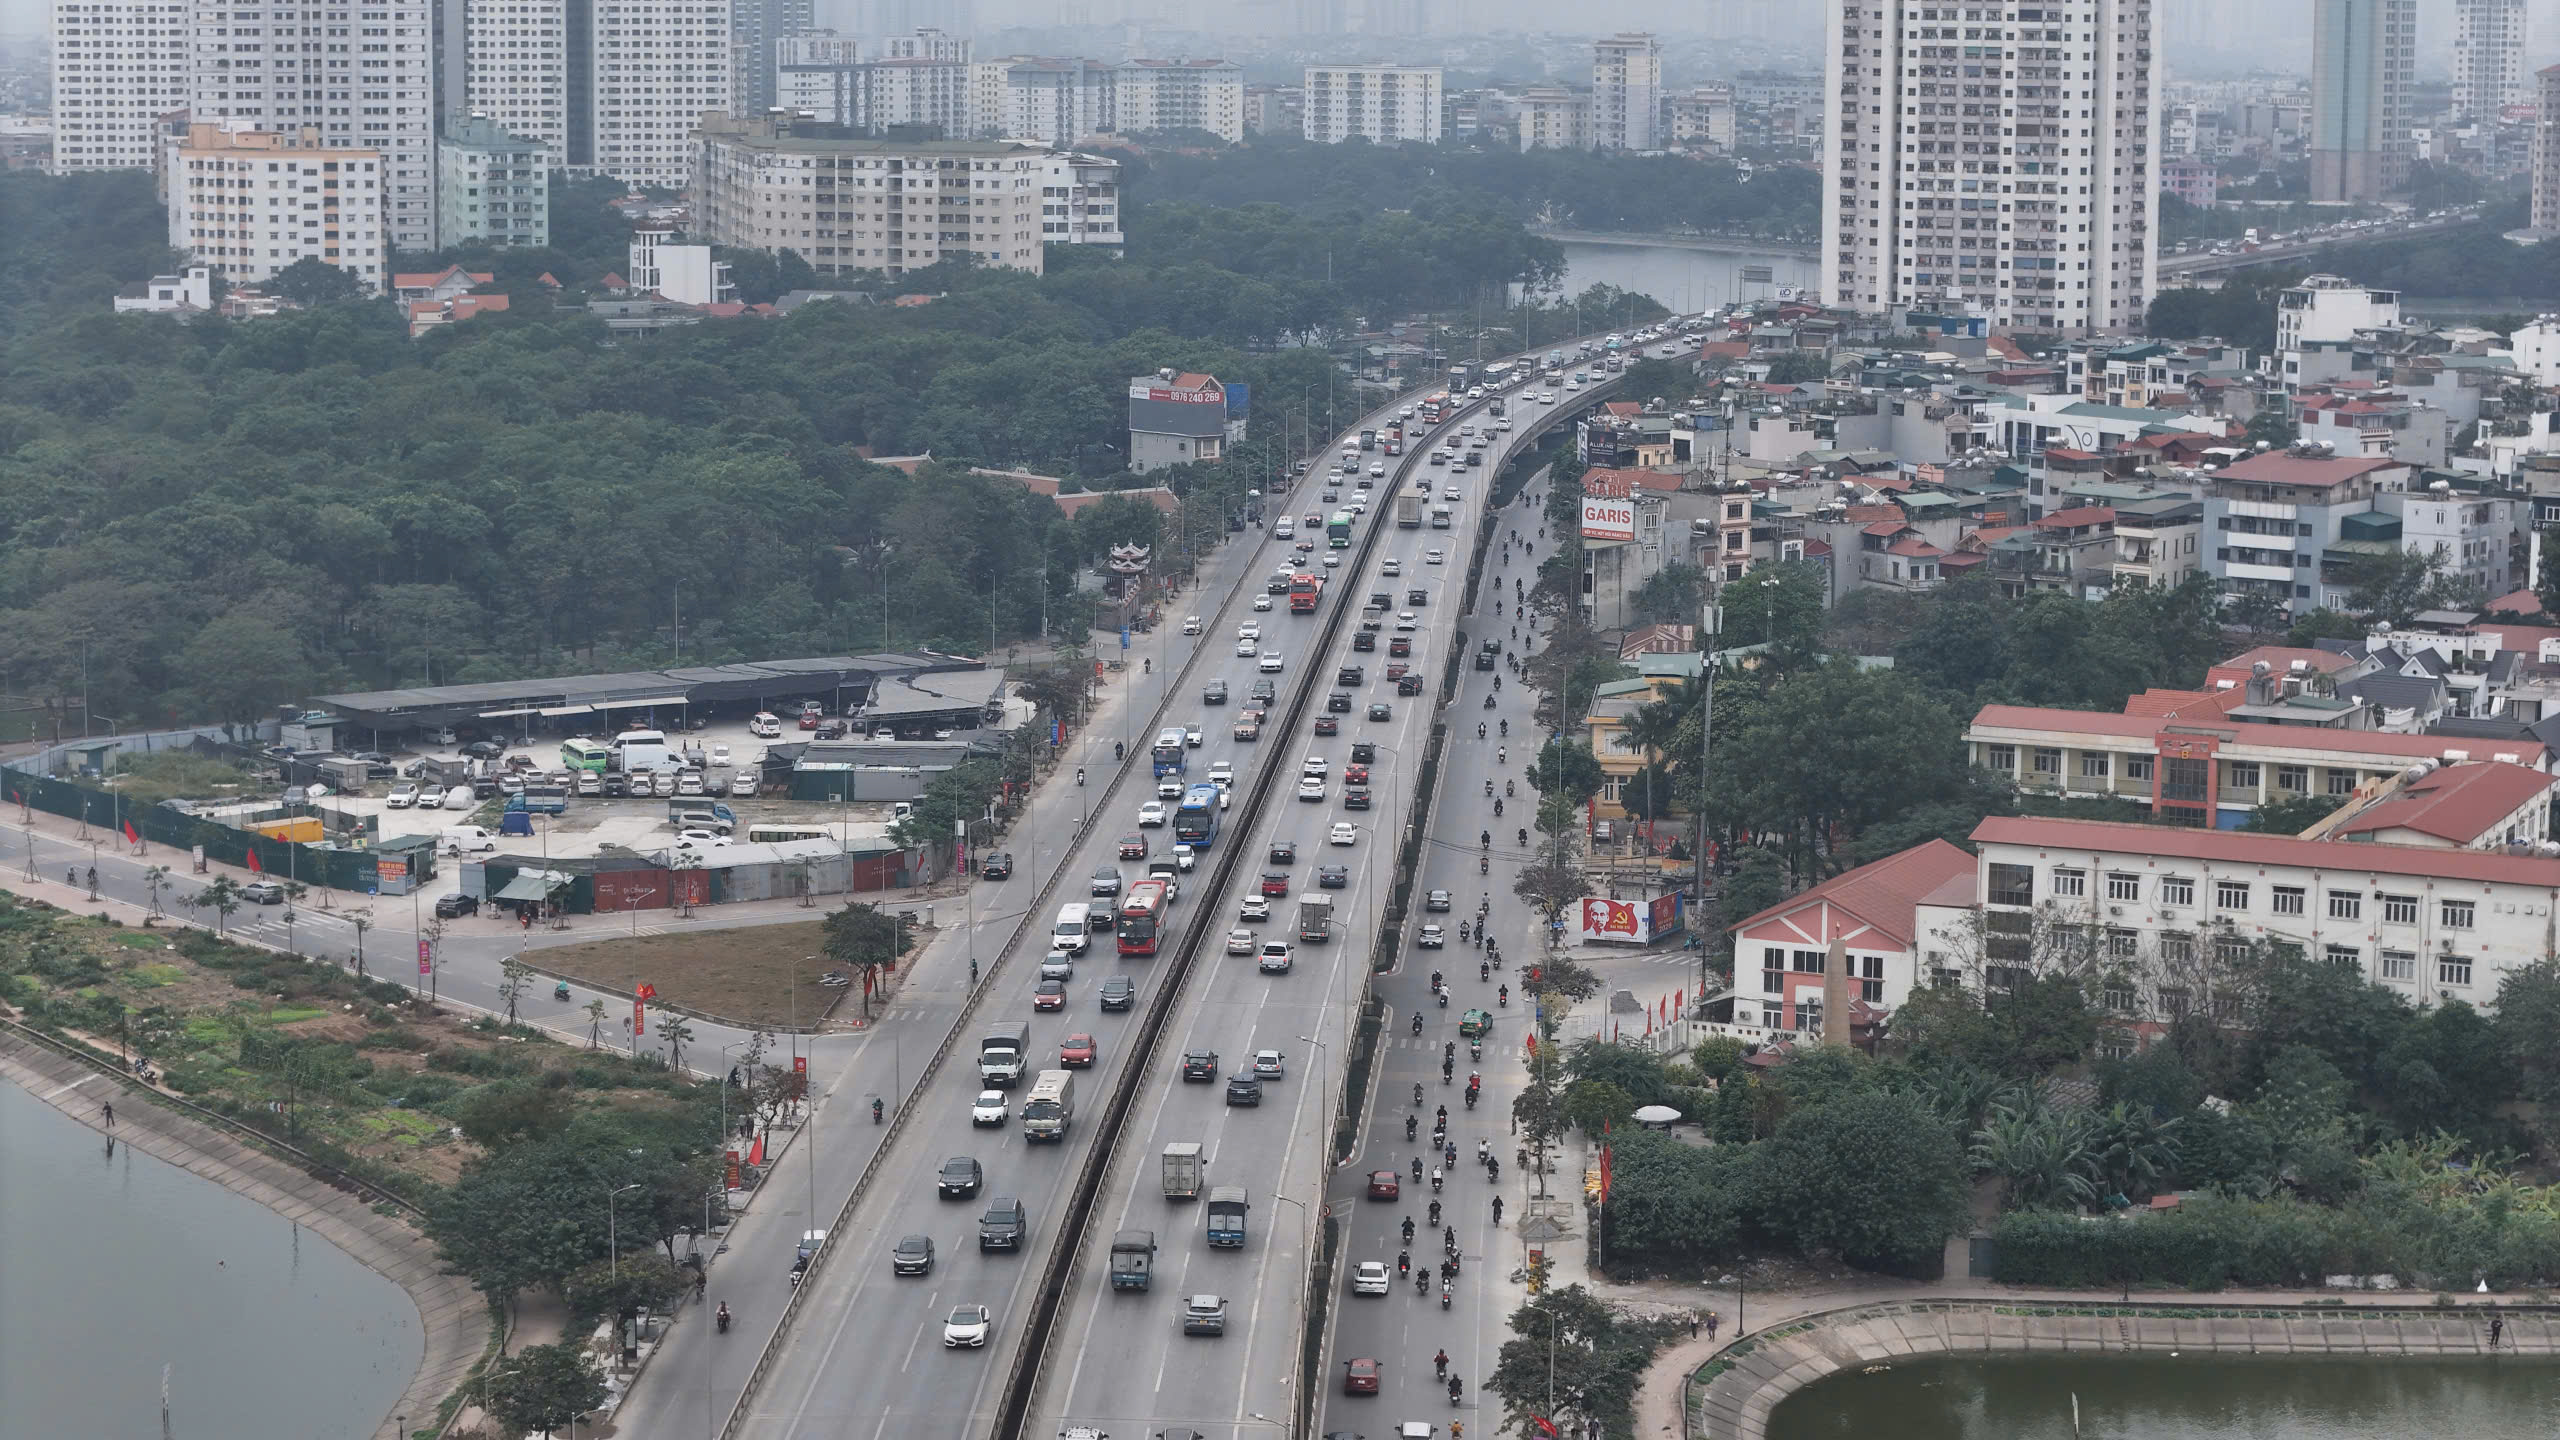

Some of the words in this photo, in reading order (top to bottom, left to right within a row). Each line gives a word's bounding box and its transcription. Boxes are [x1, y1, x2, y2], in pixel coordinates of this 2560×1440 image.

[1171, 391, 1187, 401] 0976
[1188, 393, 1203, 403] 240
[1204, 392, 1219, 402] 269
[1586, 481, 1631, 498] GARIS
[1585, 507, 1631, 524] GARIS
